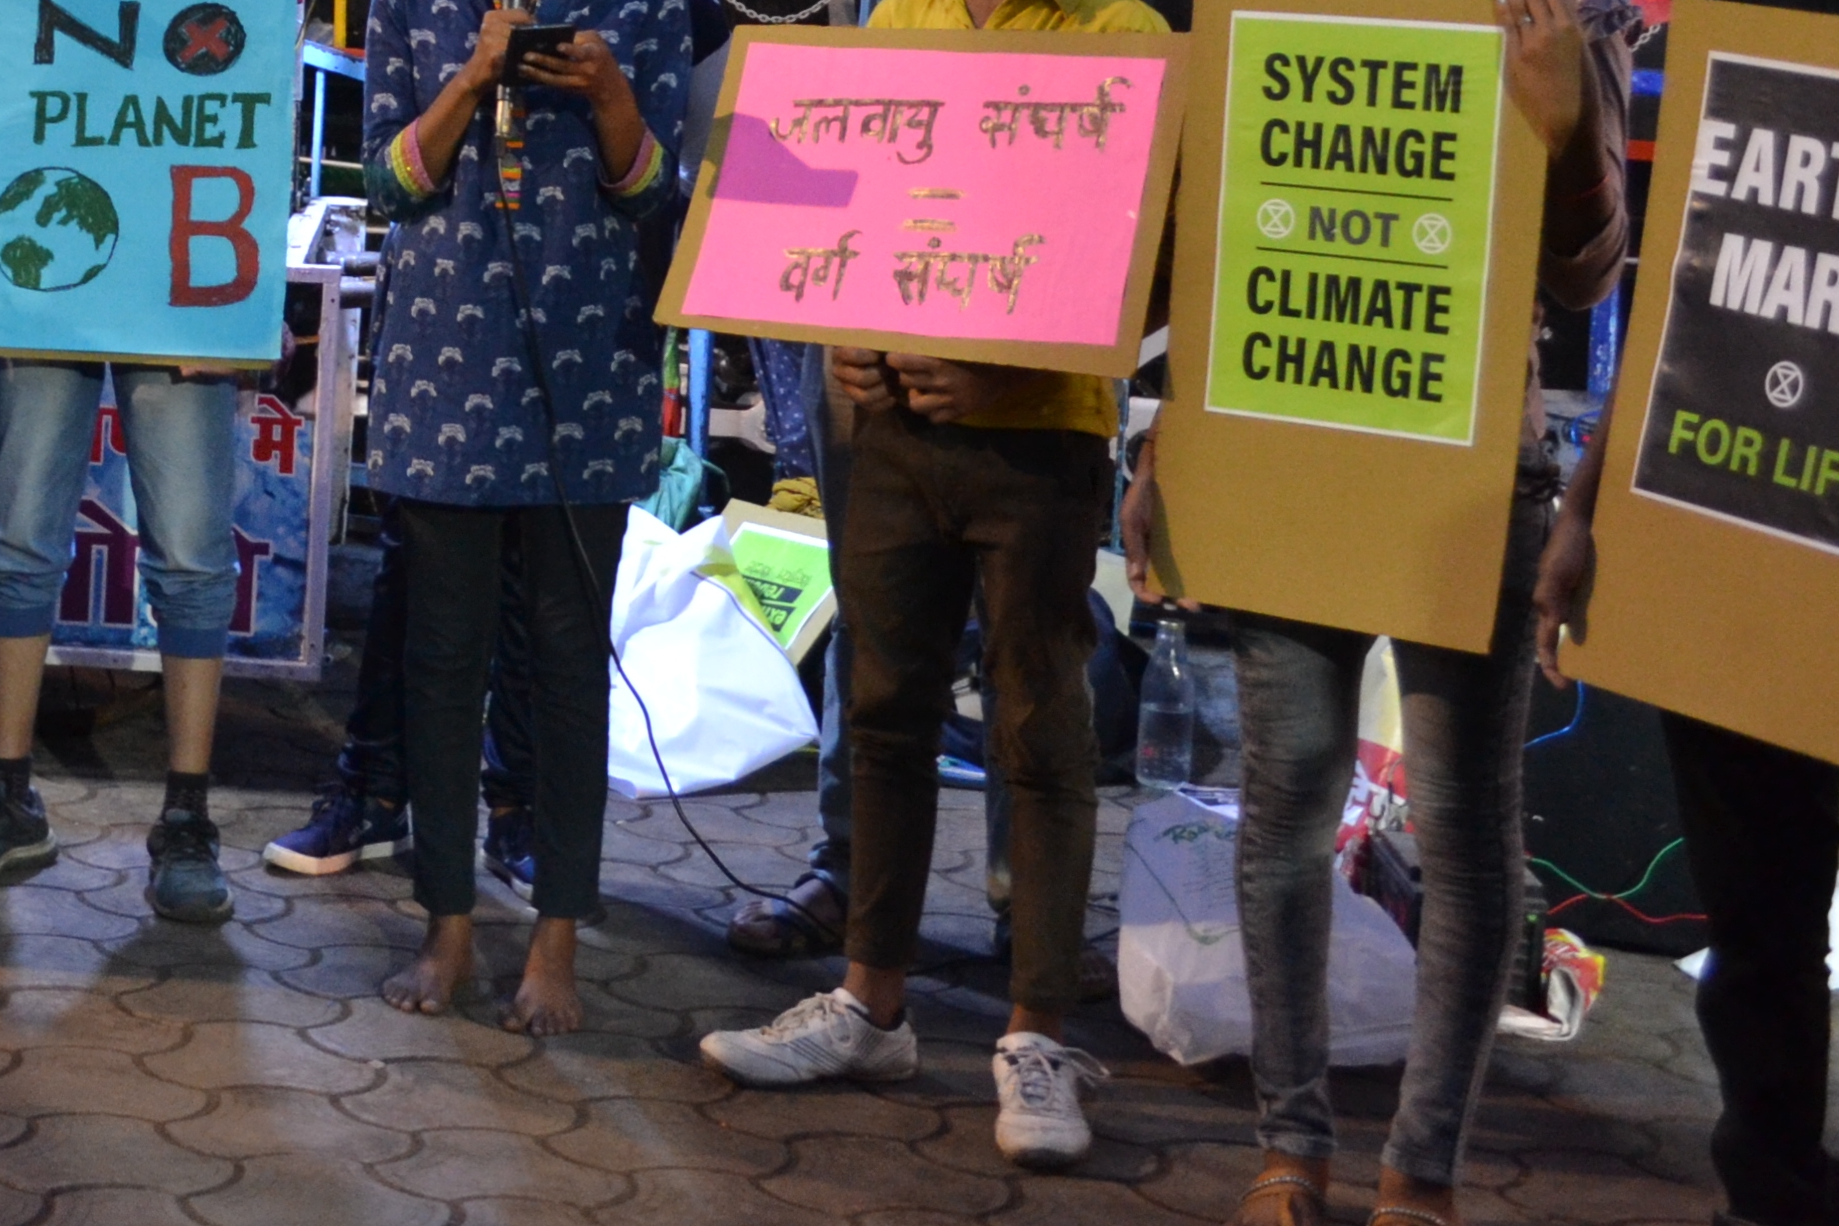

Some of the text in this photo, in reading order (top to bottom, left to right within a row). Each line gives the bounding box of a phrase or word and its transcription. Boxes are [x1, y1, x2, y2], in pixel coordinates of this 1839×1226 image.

[1262, 52, 1464, 114] SYSTEM
[29, 90, 272, 149] PLANET
[769, 76, 1135, 165] जलवायु संघर्ष
[1260, 118, 1457, 182] CHANGE
[168, 165, 260, 307] B
[1307, 205, 1399, 248] NOT
[779, 229, 1047, 314] वर्ग संघर्ष
[1247, 266, 1452, 335] CLIMATE
[1709, 232, 1839, 336] MAR
[1242, 331, 1446, 403] CHANGE
[1667, 409, 1839, 496] FOR LIF
